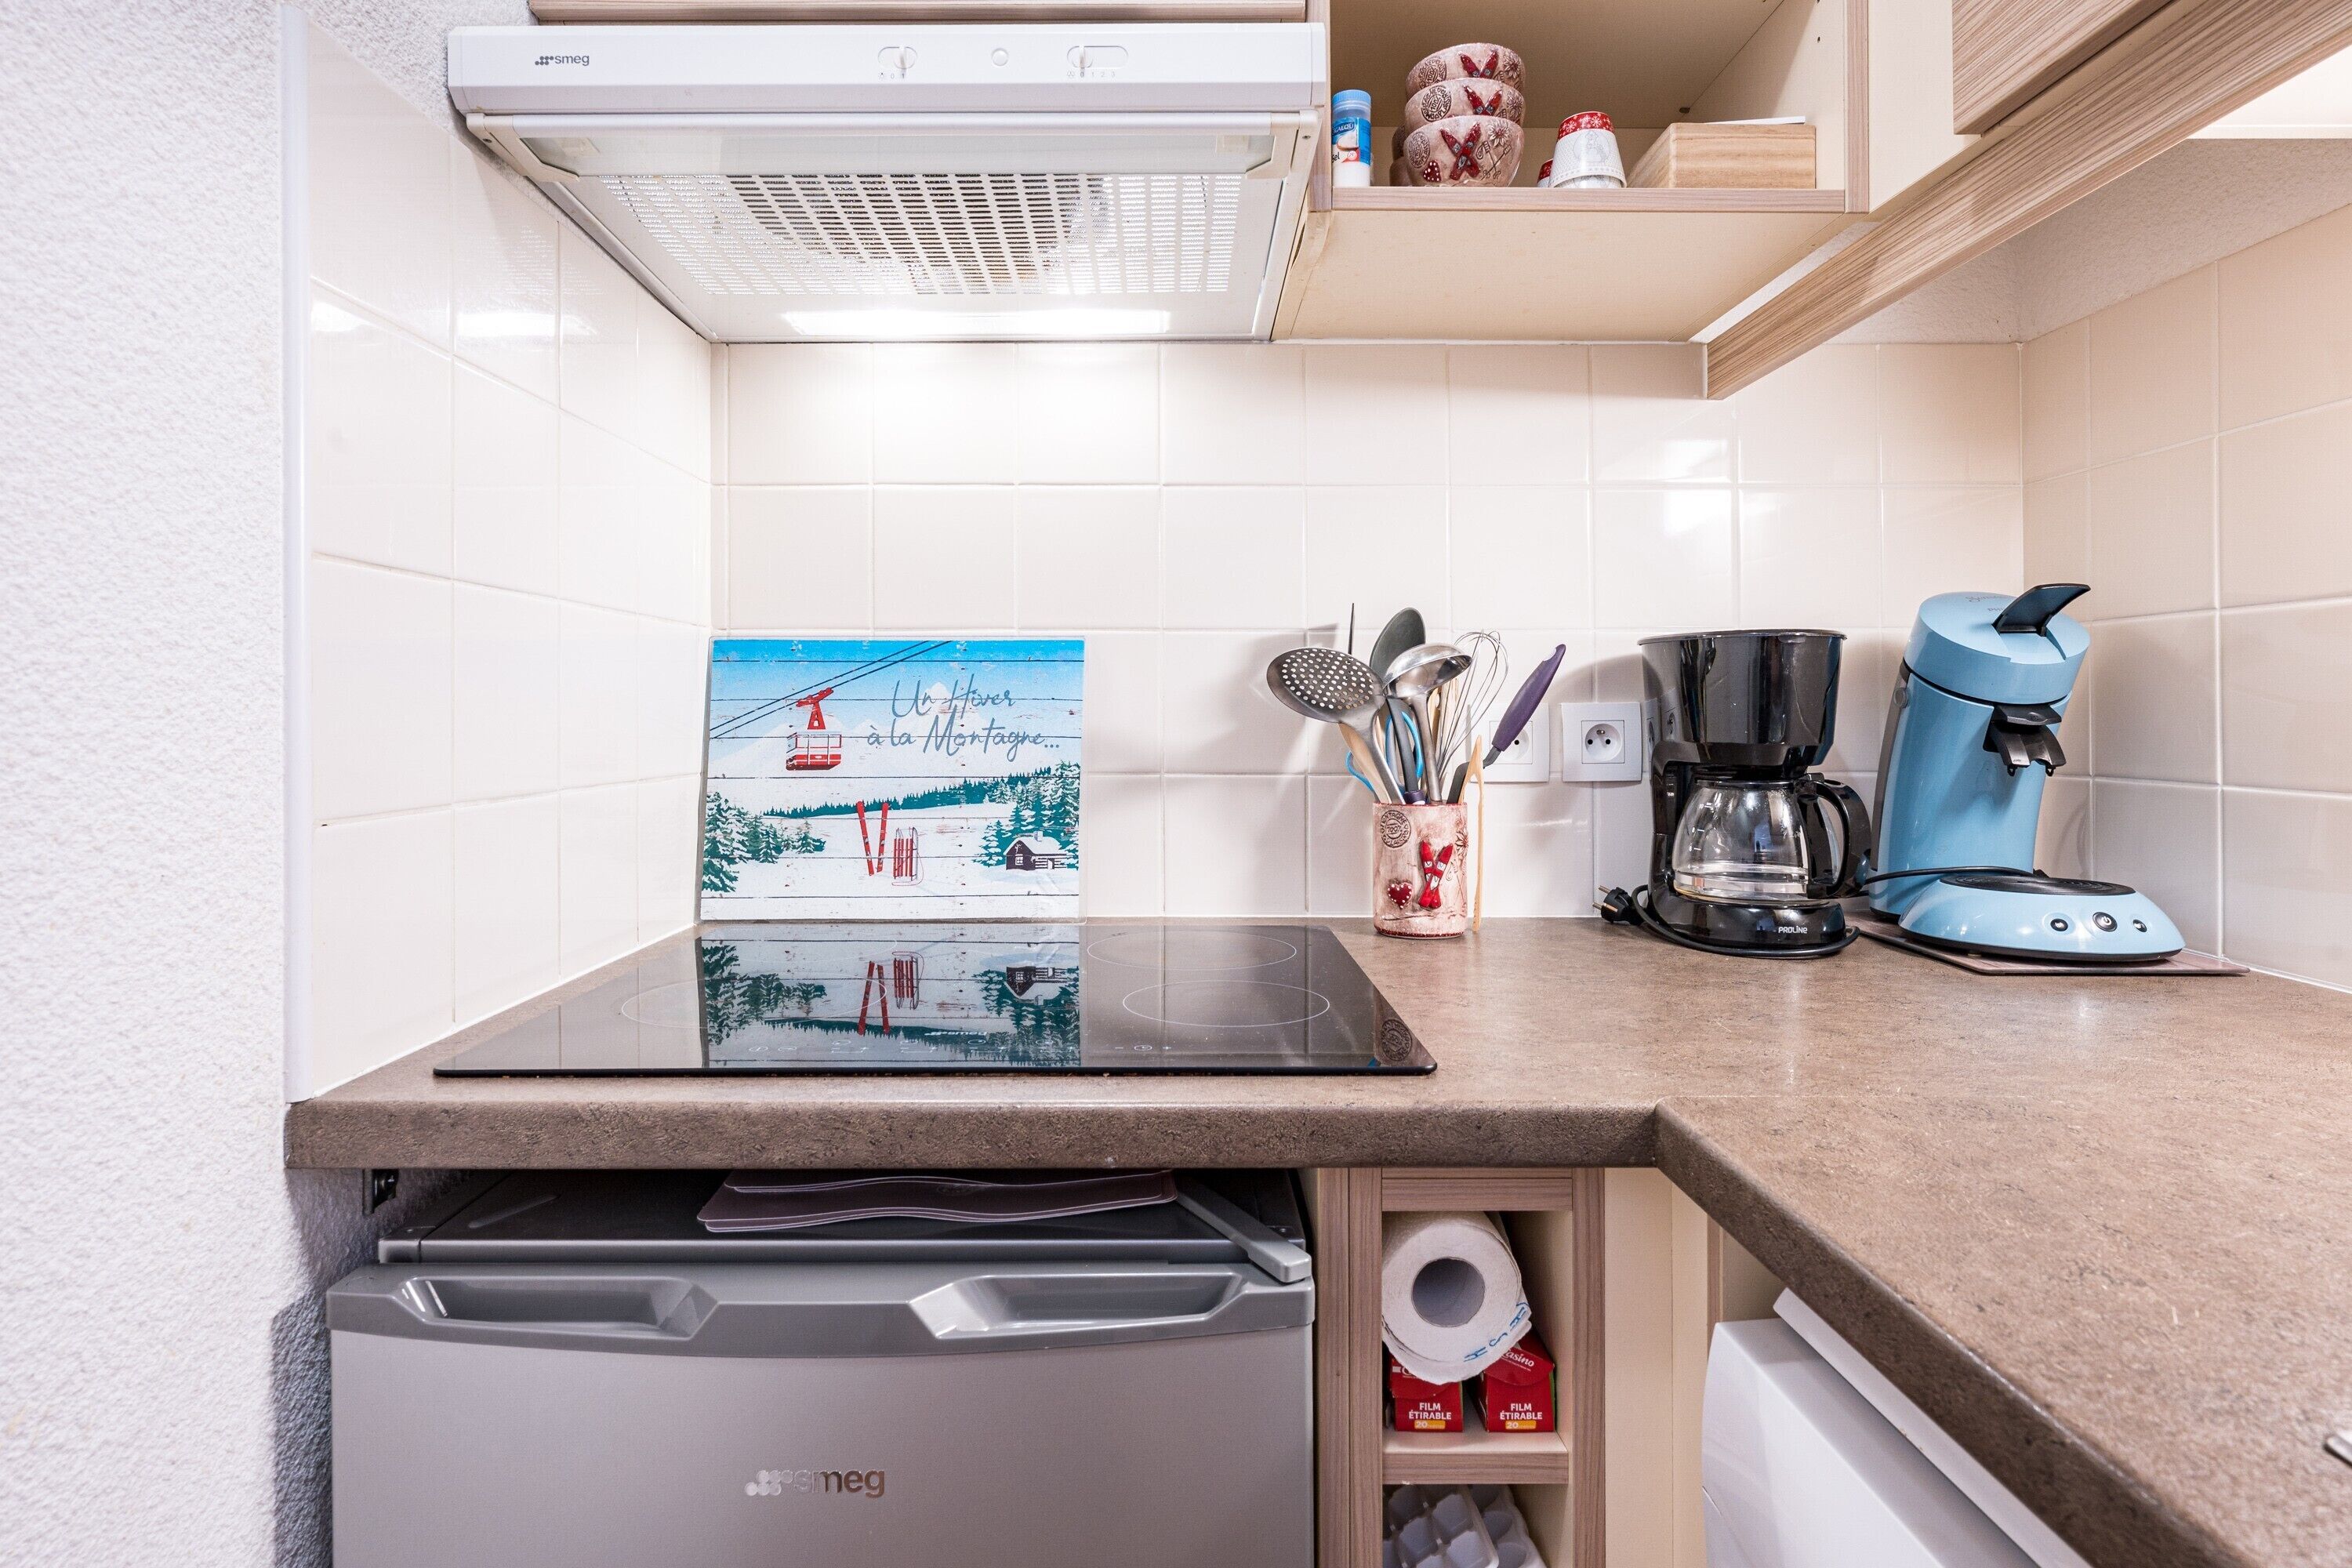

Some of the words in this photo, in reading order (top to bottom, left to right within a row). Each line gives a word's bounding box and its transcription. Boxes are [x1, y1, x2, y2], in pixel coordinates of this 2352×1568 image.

[554, 55, 590, 67] smeg
[892, 680, 936, 717] Un
[942, 673, 1016, 719] Hiver
[867, 725, 884, 746] à
[891, 717, 916, 746] la
[1503, 1350, 1535, 1367] asino
[1420, 1403, 1441, 1411] FILM
[1408, 1410, 1452, 1420] ÉTIRABLE
[1500, 1410, 1543, 1420] ÉTIRABLE
[794, 1469, 885, 1497] smeg
